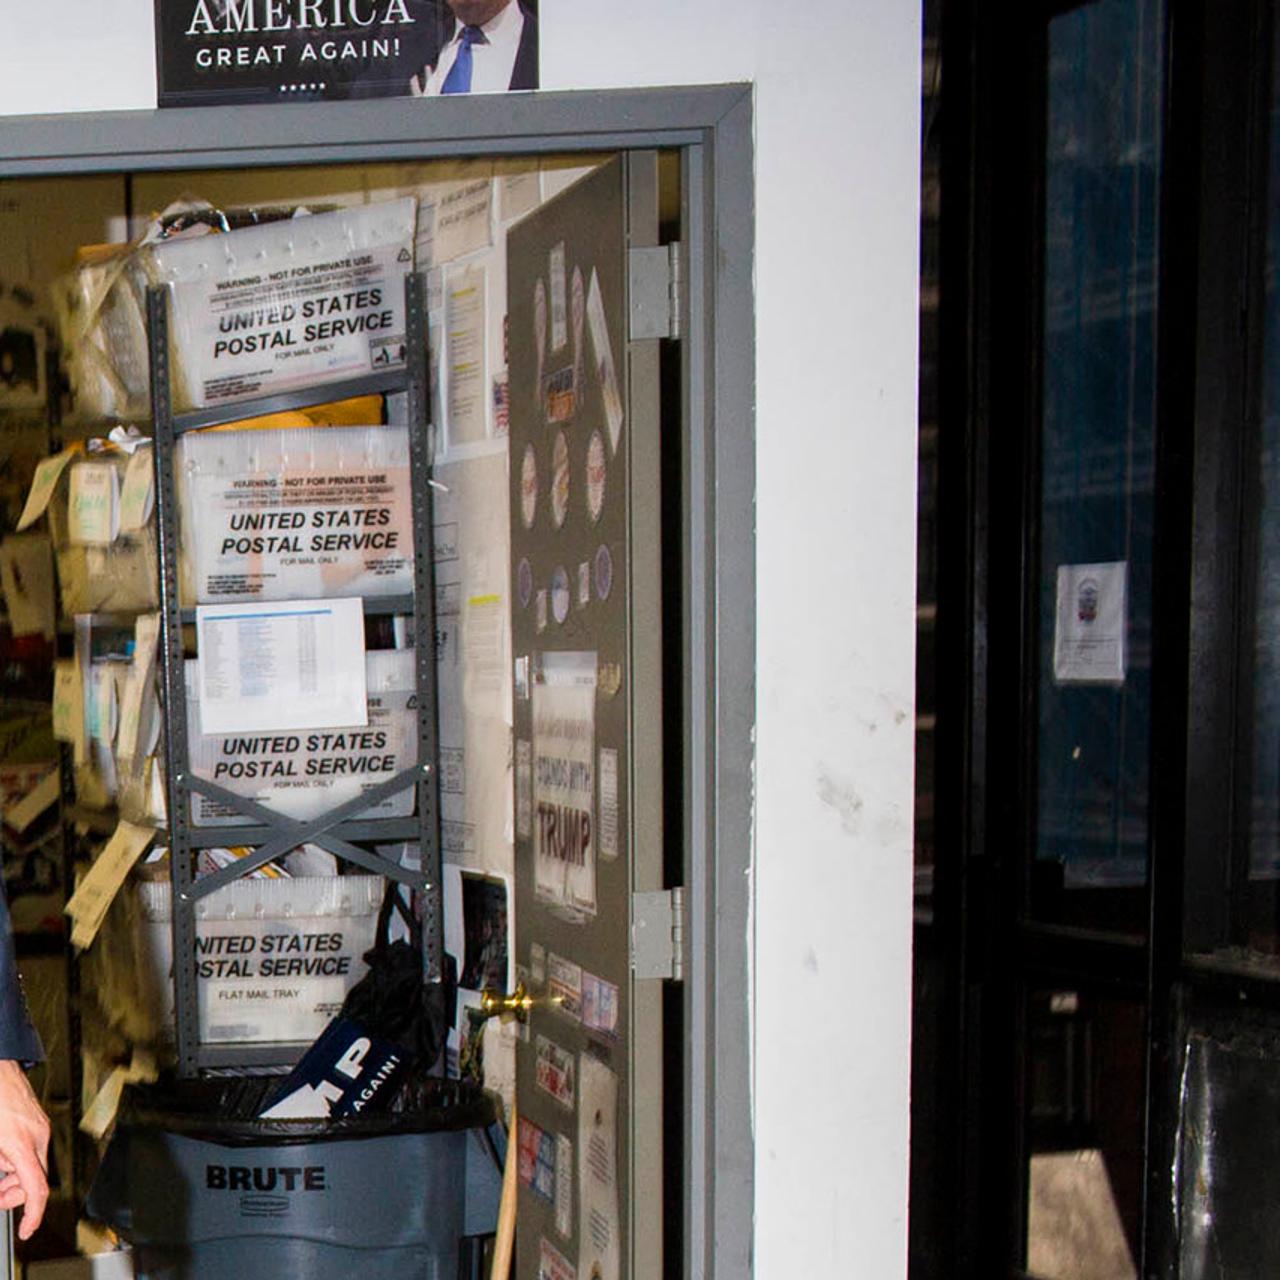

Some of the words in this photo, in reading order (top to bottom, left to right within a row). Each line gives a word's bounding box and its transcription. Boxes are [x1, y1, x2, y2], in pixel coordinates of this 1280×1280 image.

[184, 0, 416, 35] AMERICA
[196, 45, 287, 67] GREAT
[301, 39, 400, 62] AGAIN!
[269, 270, 288, 281] NOT
[291, 266, 310, 277] FOR
[313, 260, 352, 274] PRIVATE
[354, 255, 373, 266] USE
[219, 304, 296, 333] UNITED
[302, 289, 382, 318] STATES
[214, 332, 297, 359] POSTAL
[304, 310, 393, 342] SERVICE
[233, 479, 277, 488] WARNING
[285, 477, 303, 487] NOT
[307, 477, 326, 486] FOR
[328, 476, 365, 485] PRIVATE
[368, 475, 387, 484] USE
[230, 512, 306, 531] UNITED
[312, 508, 391, 528] STATES
[221, 536, 303, 555] POSTAL
[311, 532, 399, 551] SERVICE
[223, 736, 300, 755] UNITED
[306, 731, 387, 751] STATES
[214, 761, 298, 780] POSTAL
[305, 754, 396, 776] SERVICE
[538, 801, 591, 868] TRUMP
[193, 935, 257, 955] NITED
[260, 933, 343, 953] STATES
[194, 959, 254, 979] STAL
[259, 957, 352, 977] SERVICE
[218, 990, 244, 1000] FLAT
[246, 990, 270, 999] MAIL
[273, 989, 301, 999] TRAY
[352, 1055, 401, 1112] AGAIN!
[206, 1165, 325, 1191] BRUTE
